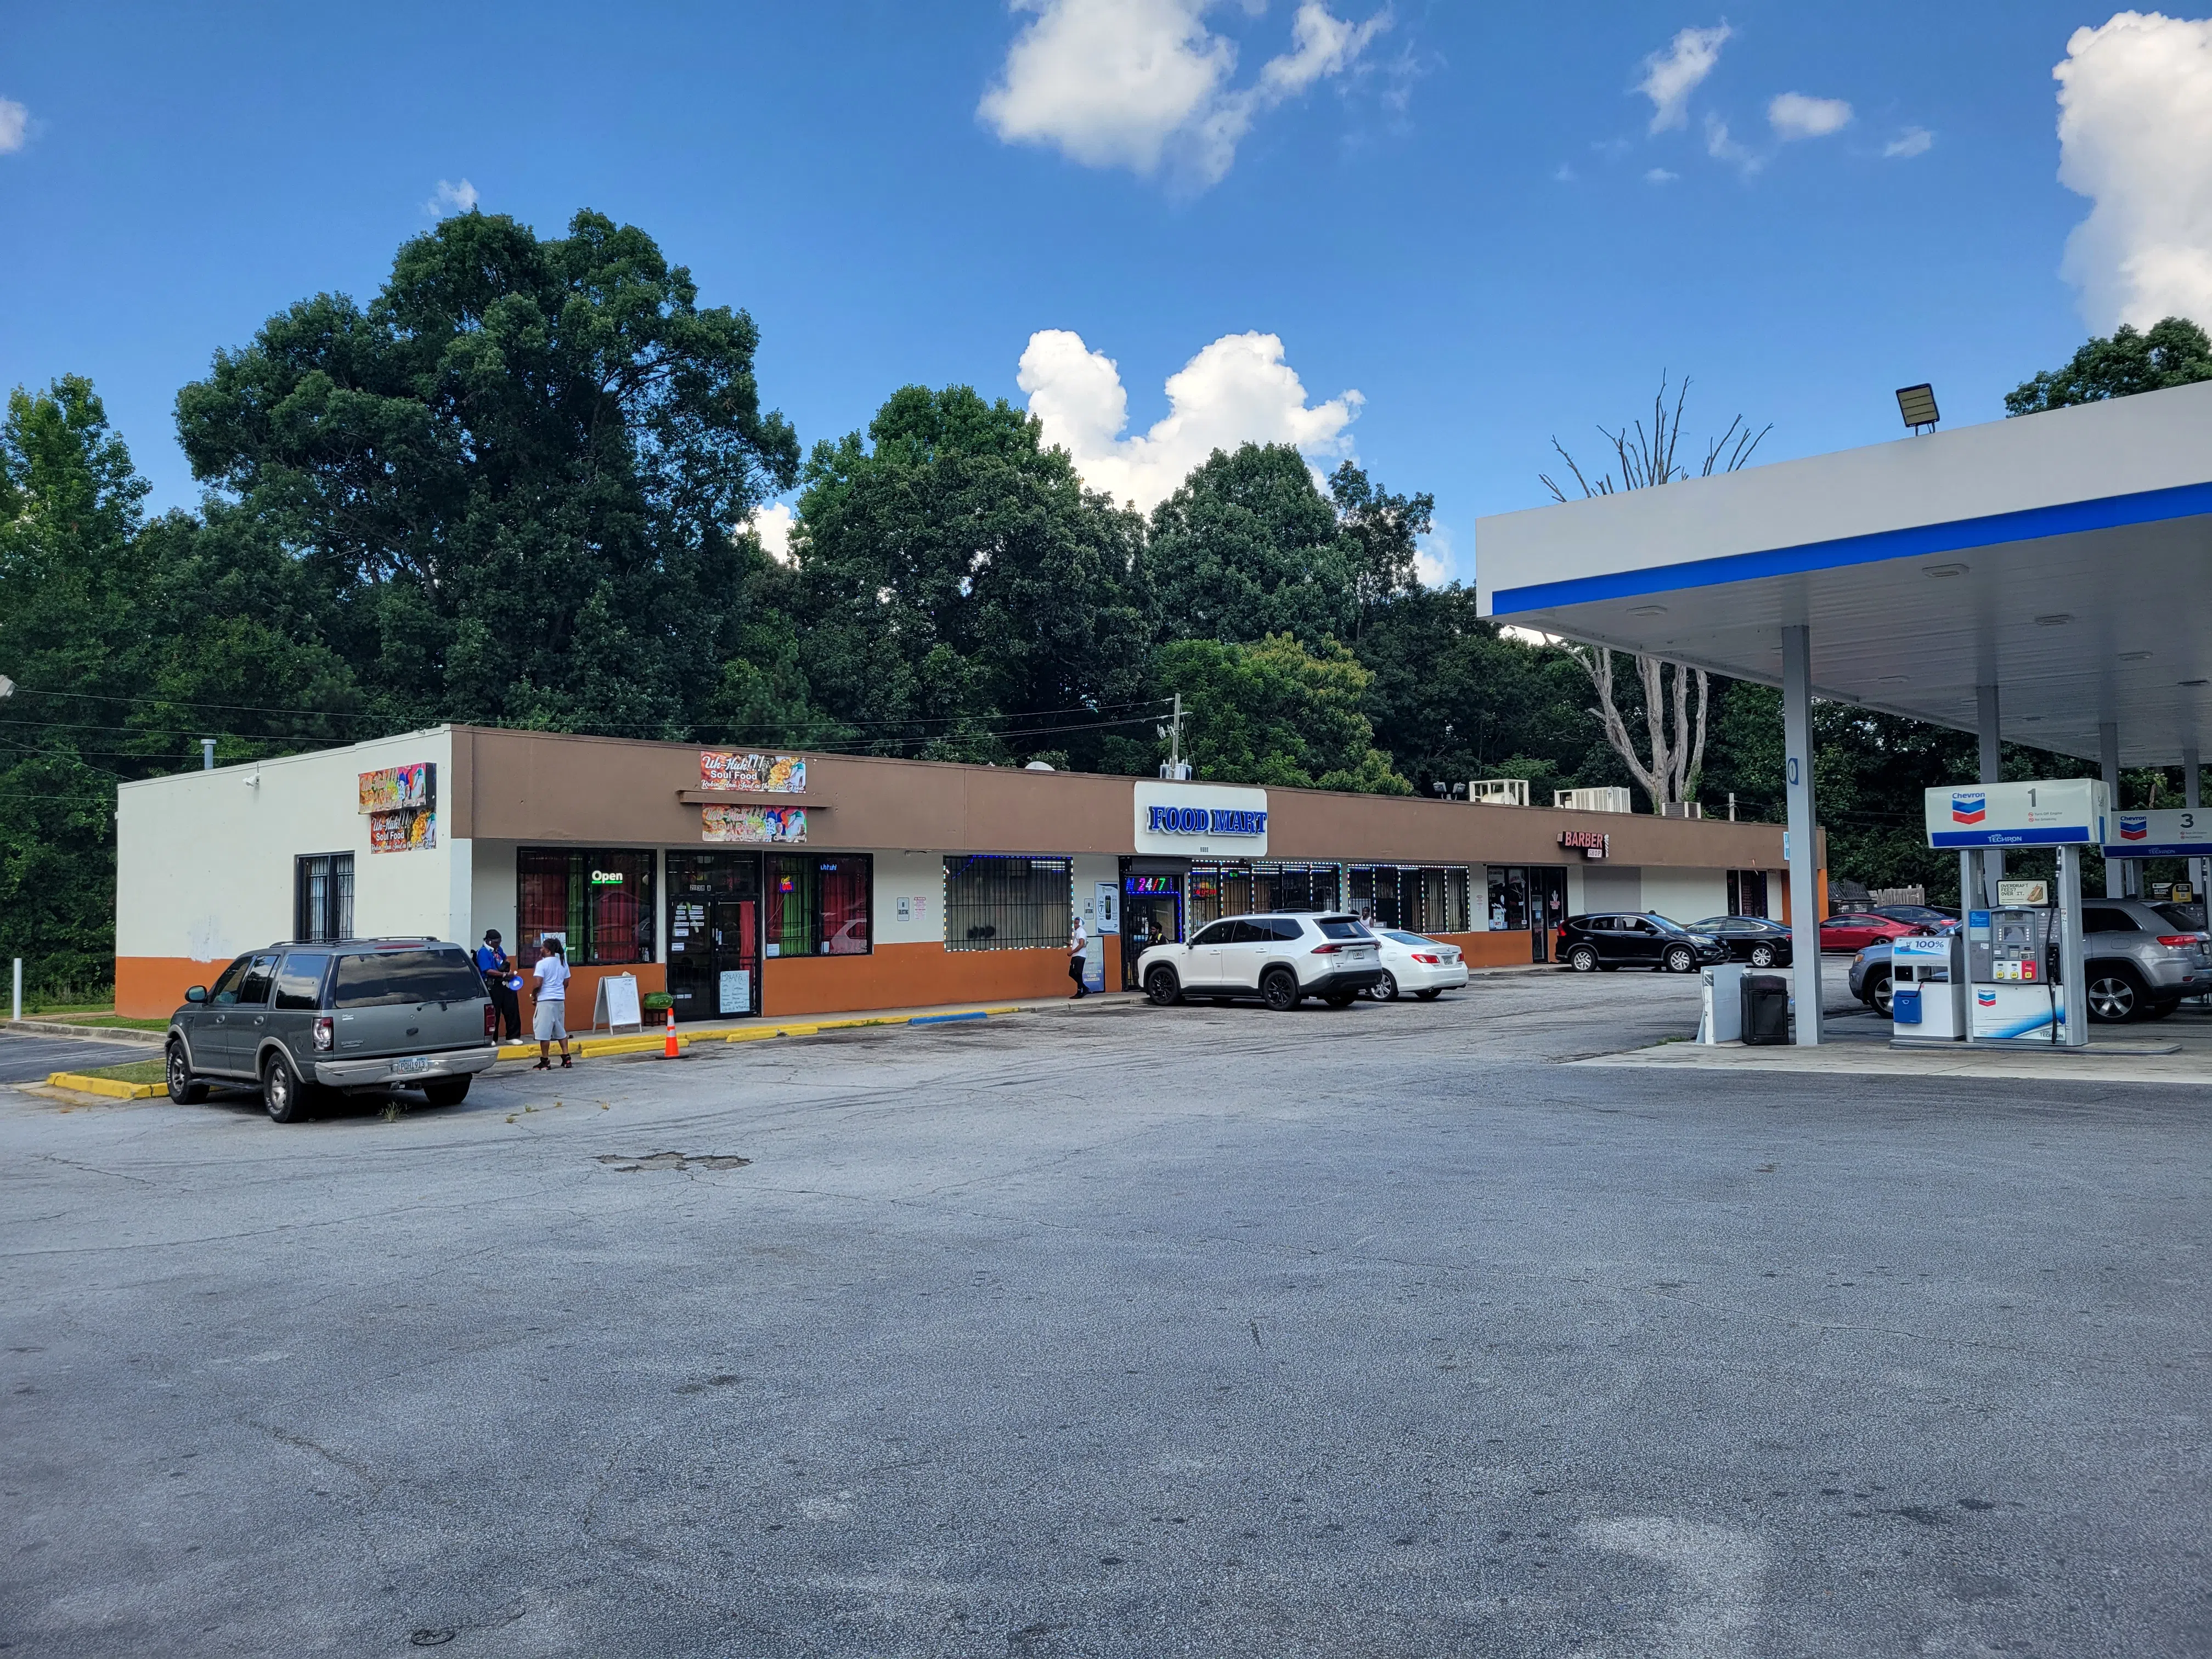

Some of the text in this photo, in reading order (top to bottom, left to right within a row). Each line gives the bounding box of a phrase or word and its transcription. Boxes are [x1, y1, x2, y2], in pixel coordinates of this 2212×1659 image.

[710, 770, 757, 780] Soul Food
[2028, 788, 2036, 807] 1
[1152, 806, 1267, 834] FOOD MART
[2180, 813, 2194, 828] 3
[376, 830, 404, 841] Soul Food
[1565, 831, 1603, 848] BARBER
[592, 870, 623, 884] Open
[1138, 878, 1166, 891] 24/7
